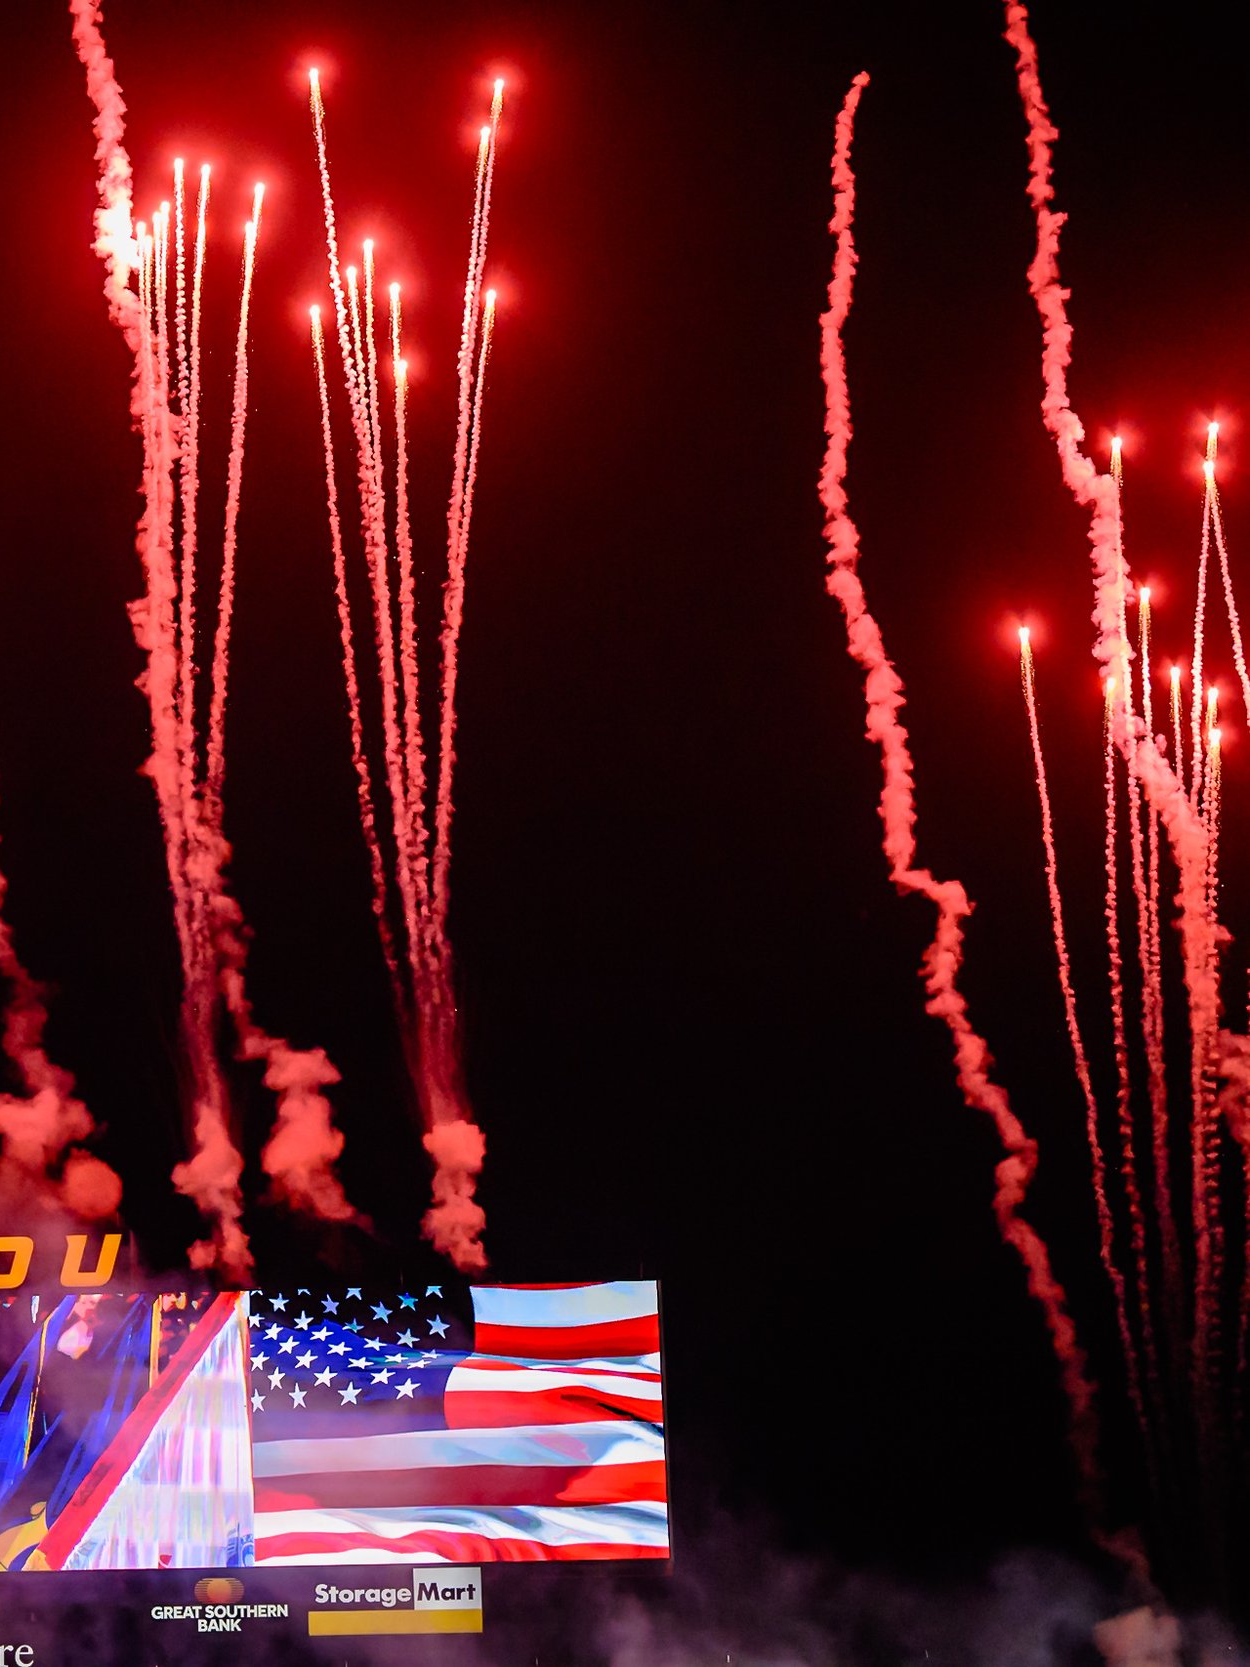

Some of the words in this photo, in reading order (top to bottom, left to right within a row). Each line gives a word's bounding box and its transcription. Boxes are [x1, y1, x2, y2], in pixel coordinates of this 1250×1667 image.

[151, 1606, 202, 1619] GREAT
[205, 1604, 289, 1618] SOUTHERN
[198, 1618, 242, 1632] BANK
